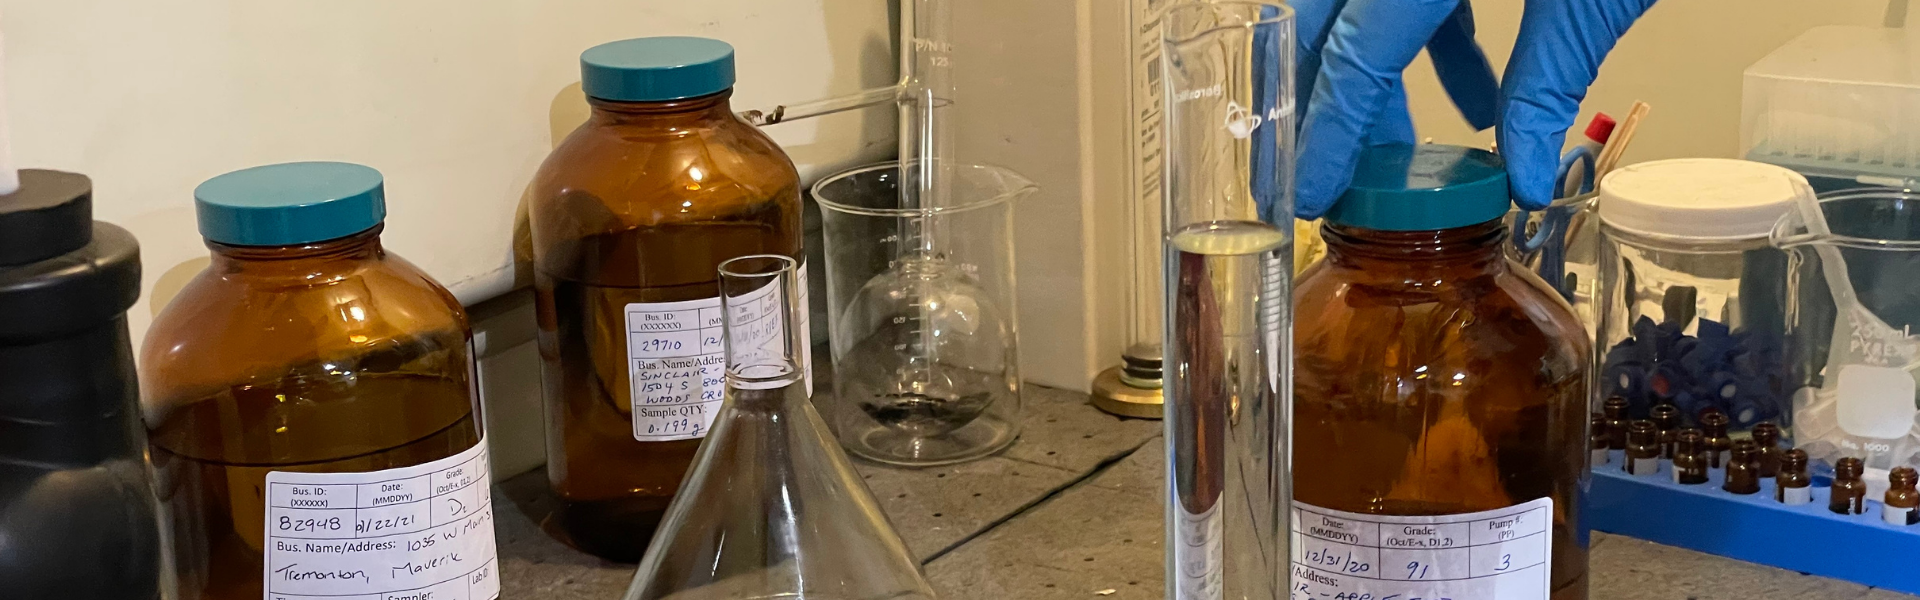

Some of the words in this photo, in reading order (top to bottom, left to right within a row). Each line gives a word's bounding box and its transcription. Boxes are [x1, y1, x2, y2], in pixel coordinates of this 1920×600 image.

[645, 313, 660, 321] Bus.
[664, 312, 676, 320] ID:
[643, 339, 682, 352] 29710
[638, 360, 659, 370] Bus.
[640, 367, 708, 381] SINCLAIR
[641, 382, 673, 394] 1504
[681, 381, 688, 390] S
[646, 394, 691, 404] WOODS
[641, 408, 677, 419] Sample
[680, 404, 708, 417] QTY:
[648, 419, 688, 433] 0.199
[1863, 442, 1890, 452] 1000
[292, 487, 311, 496] Bus.
[314, 488, 327, 496] ID:
[382, 483, 403, 492] Date:
[290, 499, 328, 508] (XXXXXX)
[372, 493, 413, 506] (MMDDYY)
[279, 516, 341, 532] 82948
[1322, 517, 1343, 528] Date:
[1403, 526, 1436, 535] Grade:
[1489, 519, 1514, 530] Pump
[407, 533, 436, 552] 1035
[443, 527, 457, 540] W
[1310, 526, 1358, 545] (MMDDYY)
[1498, 529, 1515, 540] (PP)
[277, 541, 301, 552] Bus.
[306, 541, 396, 554] Name/Address:
[275, 563, 370, 584] Tremonton,
[392, 552, 462, 579] Maverik
[1305, 548, 1370, 573] 12/31/20
[1407, 561, 1429, 579] 91
[1494, 553, 1511, 571] 3
